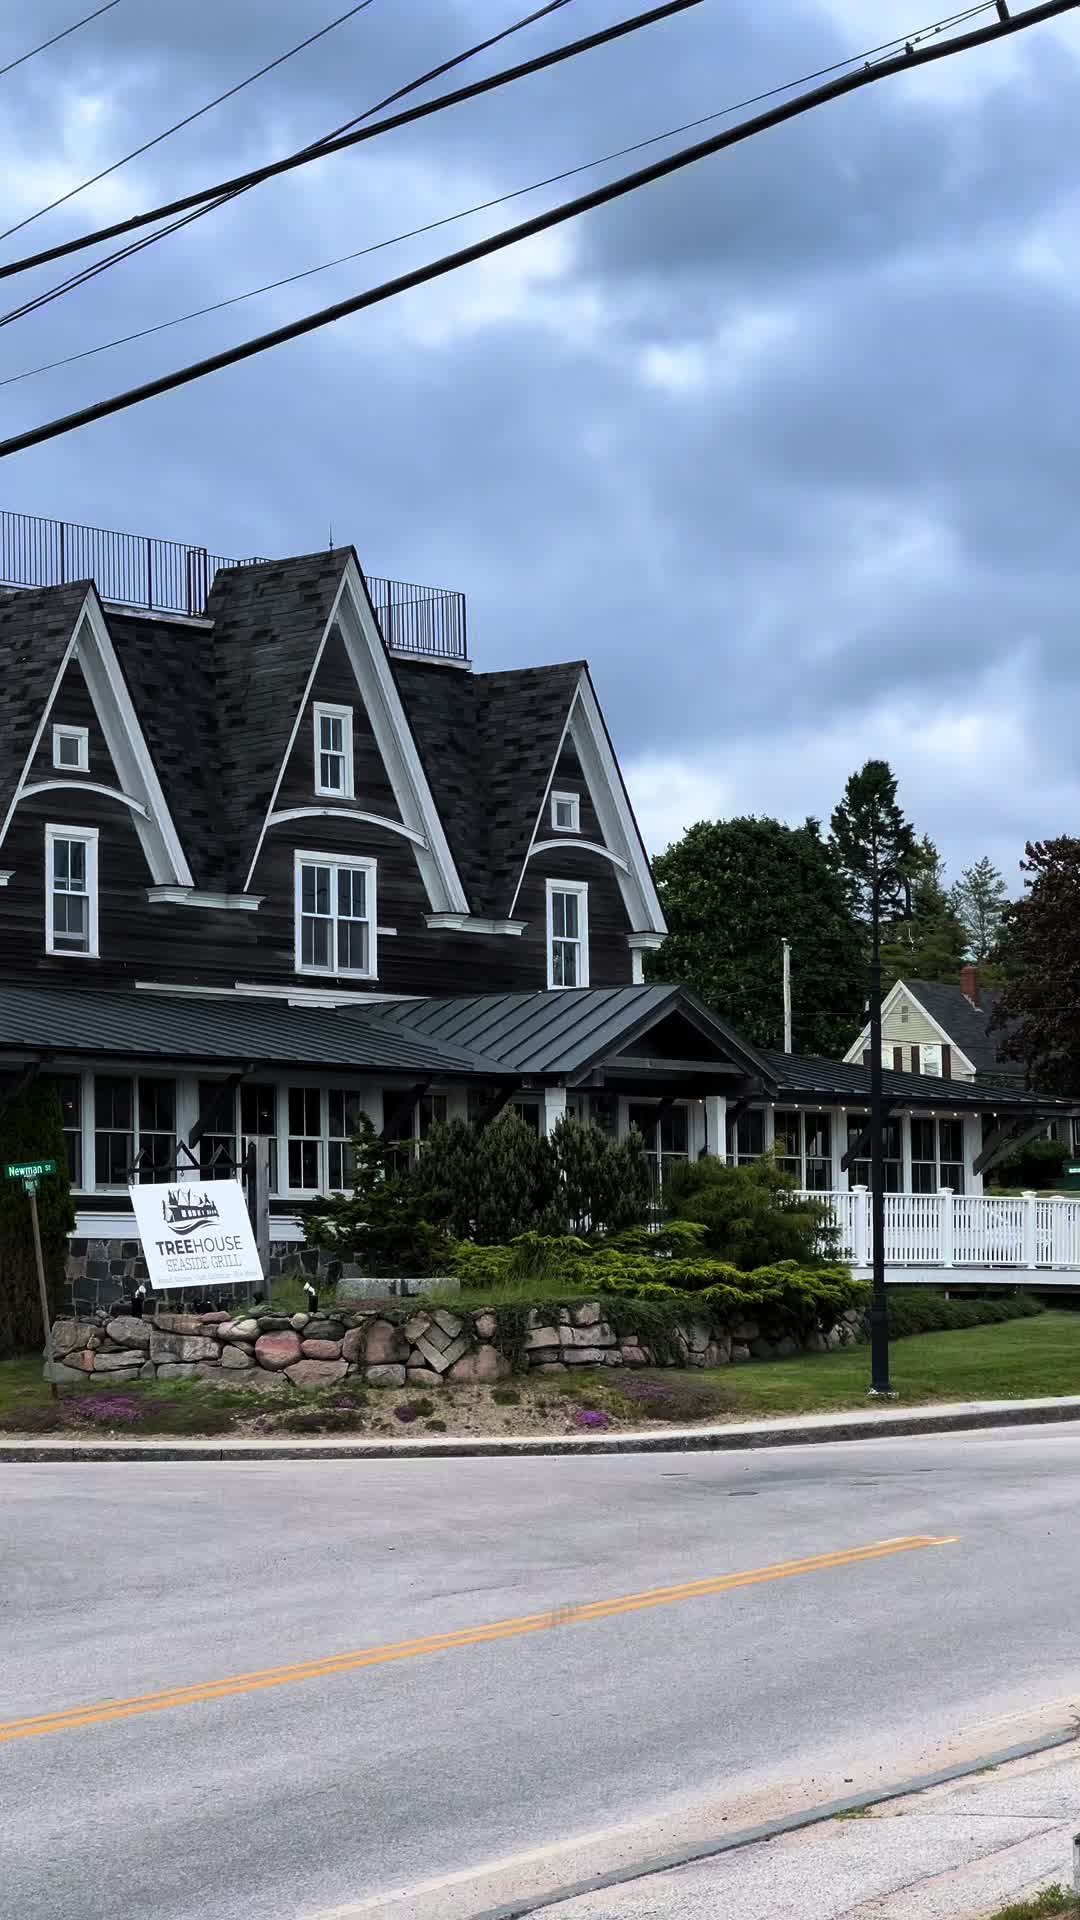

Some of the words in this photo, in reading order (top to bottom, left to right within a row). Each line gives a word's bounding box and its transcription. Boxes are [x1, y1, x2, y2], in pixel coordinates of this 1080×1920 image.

[8, 1165, 43, 1177] Newman
[44, 1164, 52, 1172] St
[155, 1235, 243, 1256] TREEHOUSE
[166, 1256, 209, 1272] SEASIDE
[211, 1254, 242, 1268] GRILL
